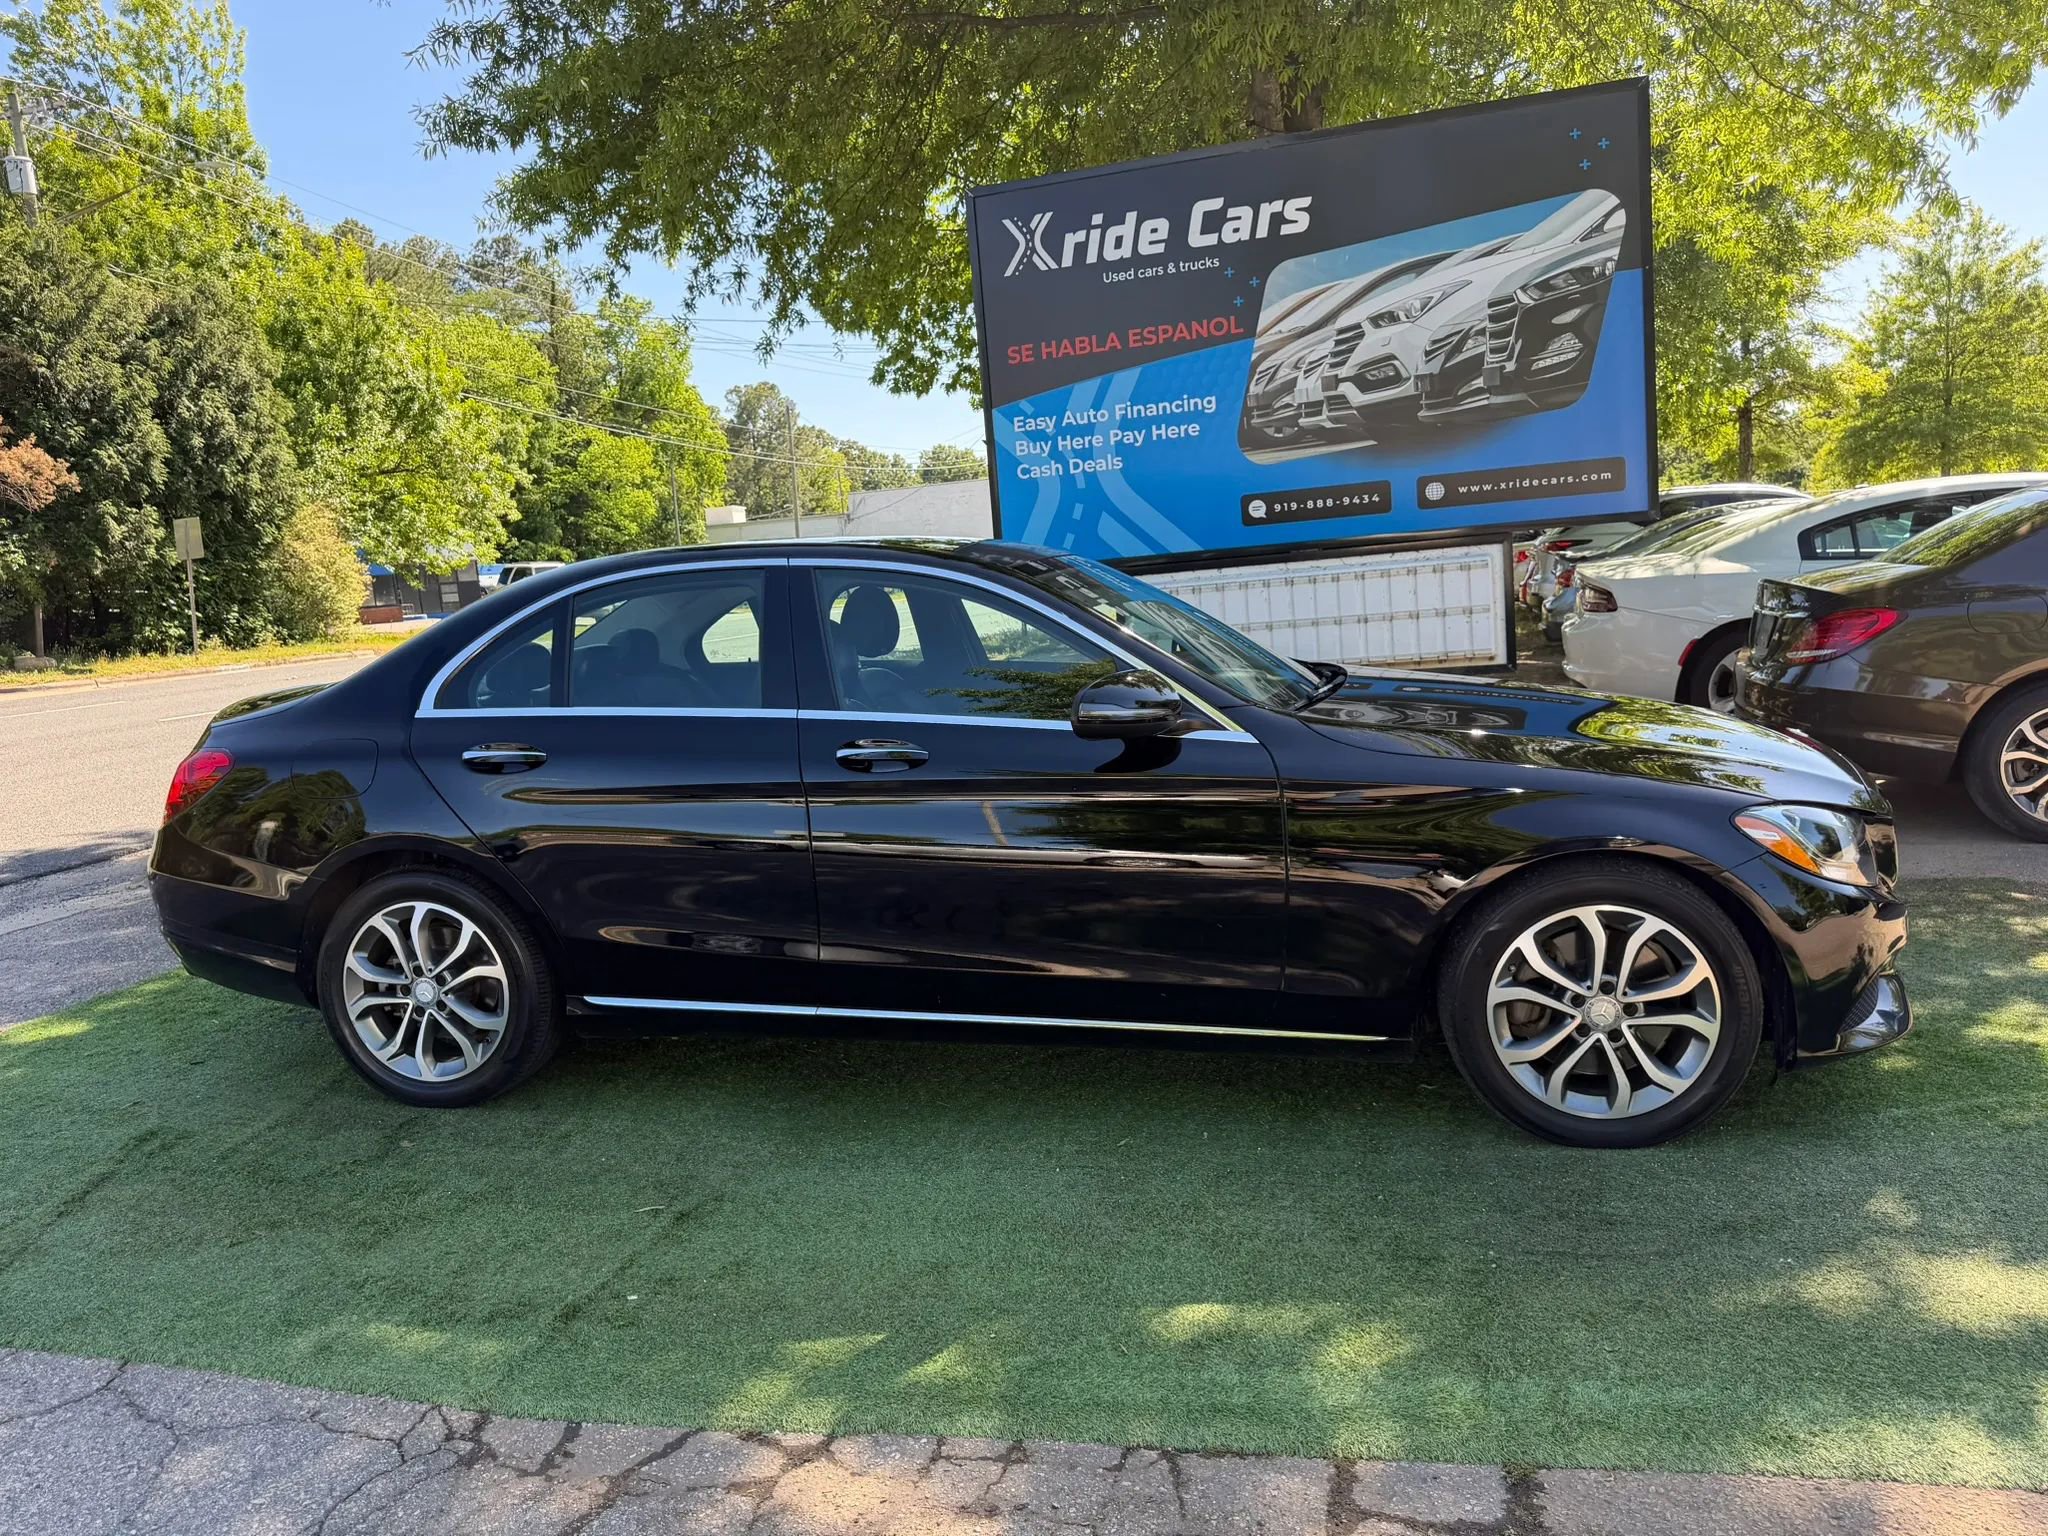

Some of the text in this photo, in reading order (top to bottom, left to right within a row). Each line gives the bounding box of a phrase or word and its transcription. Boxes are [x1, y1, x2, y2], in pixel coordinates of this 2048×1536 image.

[1187, 196, 1313, 248] Cars
[1102, 256, 1220, 283] Used cars & trucks
[1007, 315, 1244, 365] SE HABLA ESPANOL
[1013, 394, 1217, 433] Easy Auto Financing
[1015, 422, 1201, 457] Buy Here Pay Here
[1016, 454, 1124, 480] Cash Deals
[1457, 470, 1613, 494] www.xridecars.com
[1273, 493, 1381, 513] 919-888-9434
